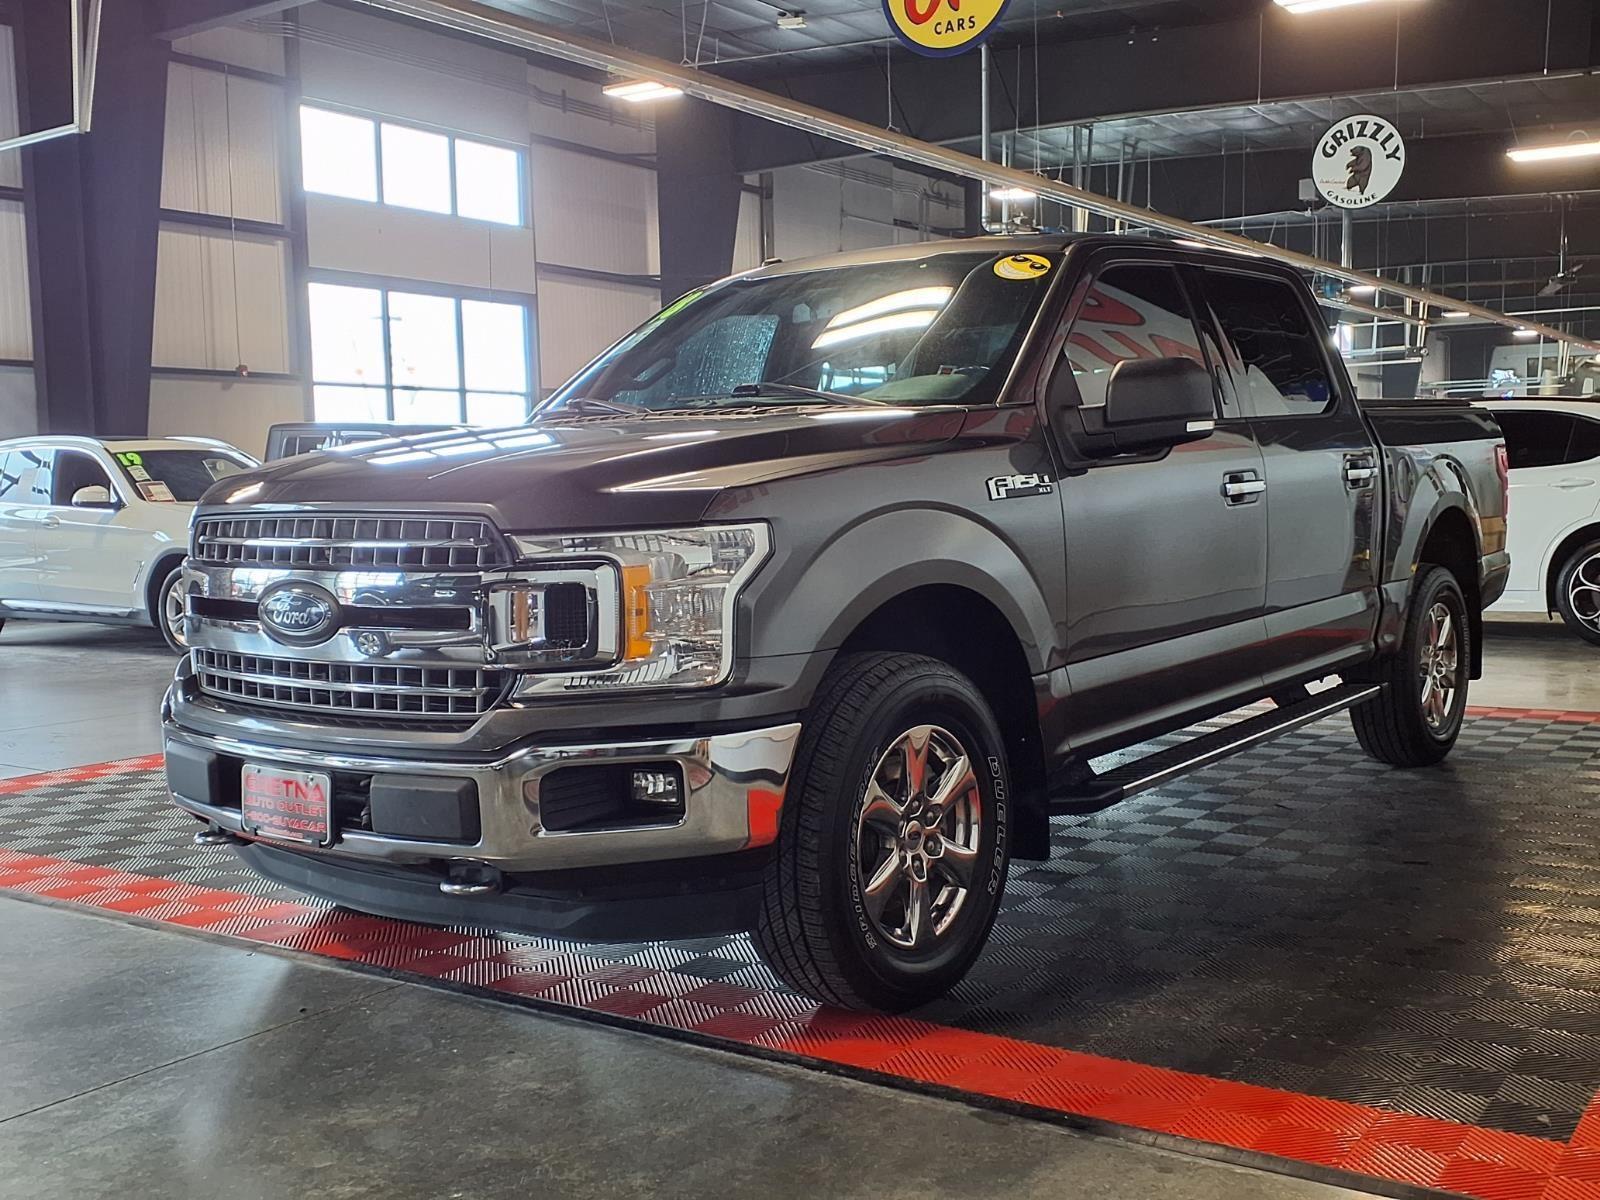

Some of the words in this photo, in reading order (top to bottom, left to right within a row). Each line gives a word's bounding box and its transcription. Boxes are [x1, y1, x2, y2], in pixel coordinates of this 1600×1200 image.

[934, 15, 976, 35] CARS
[1321, 120, 1401, 162] GRIZZLY
[1326, 190, 1378, 205] GASOLINE
[116, 452, 143, 467] 19
[1038, 486, 1051, 494] XLT
[273, 592, 311, 625] Ford
[987, 756, 1006, 896] DUELER
